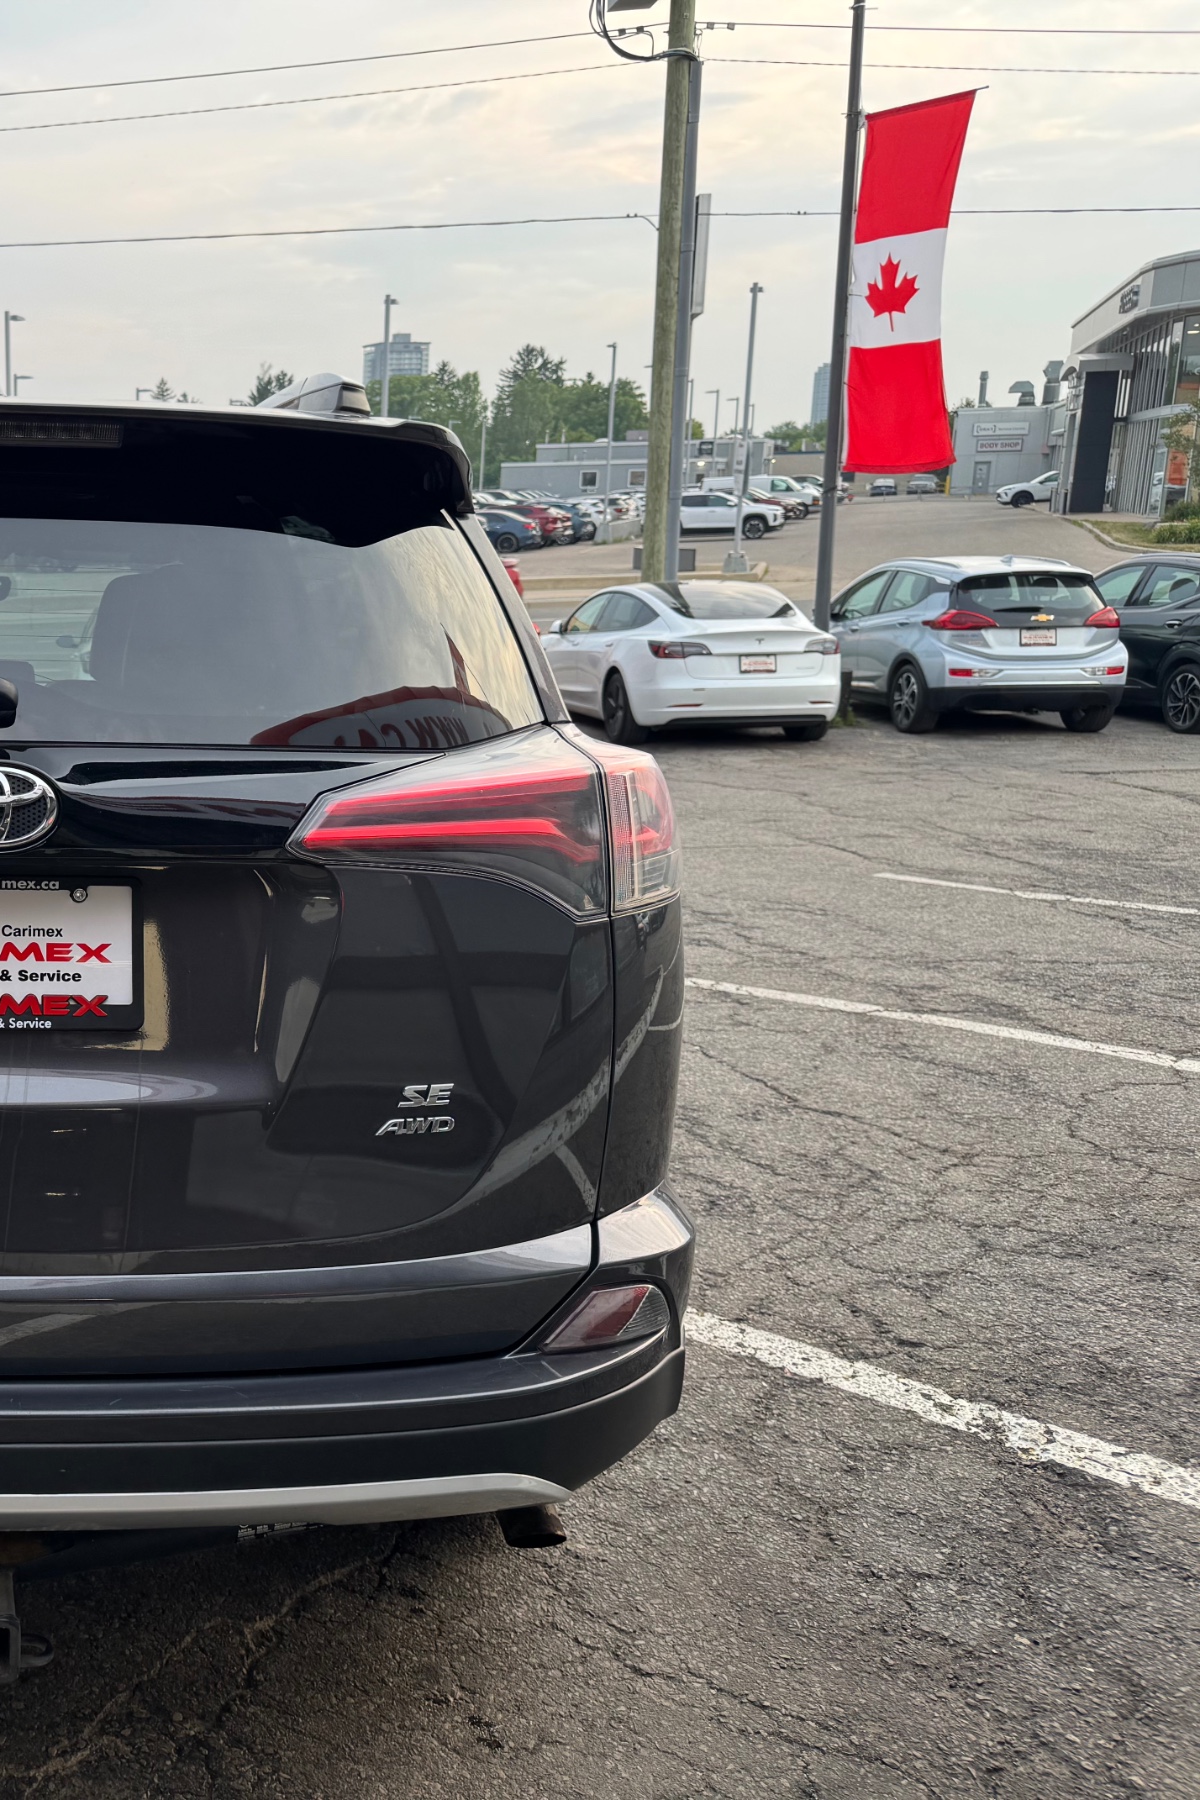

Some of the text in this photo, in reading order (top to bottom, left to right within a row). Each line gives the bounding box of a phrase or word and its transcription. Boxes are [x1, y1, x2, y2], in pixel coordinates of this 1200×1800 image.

[1000, 441, 1020, 449] SHOP
[1, 924, 63, 938] Carimex
[0, 969, 13, 982] &
[18, 969, 82, 983] Service
[8, 1018, 52, 1030] Service
[397, 1082, 455, 1108] SE
[375, 1116, 455, 1136] AWD
